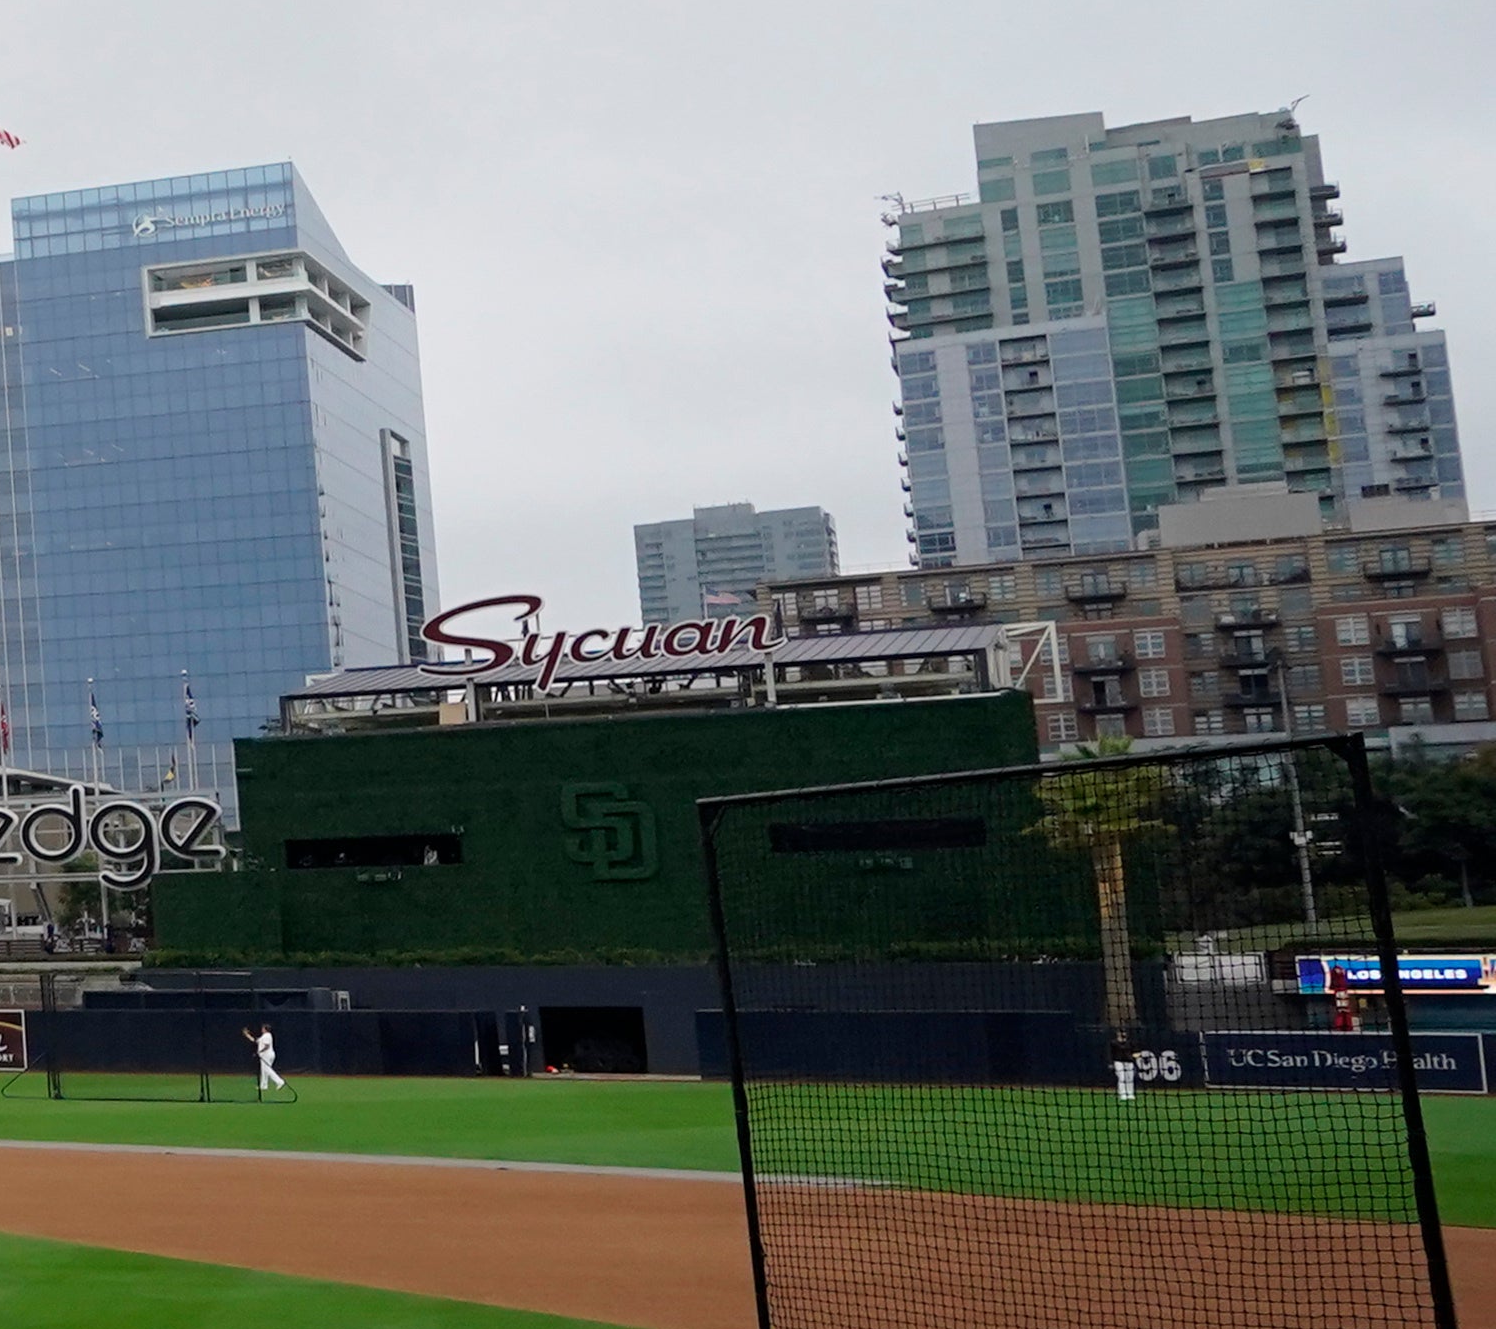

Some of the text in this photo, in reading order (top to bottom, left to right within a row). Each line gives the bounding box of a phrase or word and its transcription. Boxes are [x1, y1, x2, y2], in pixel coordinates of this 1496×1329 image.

[165, 203, 286, 228] Sempra Energy
[418, 594, 787, 692] Sycuan
[1347, 968, 1380, 980] LOS
[1399, 968, 1468, 981] NGELES
[1135, 1049, 1182, 1082] 96
[1228, 1048, 1457, 1072] UC San Diego Halth
